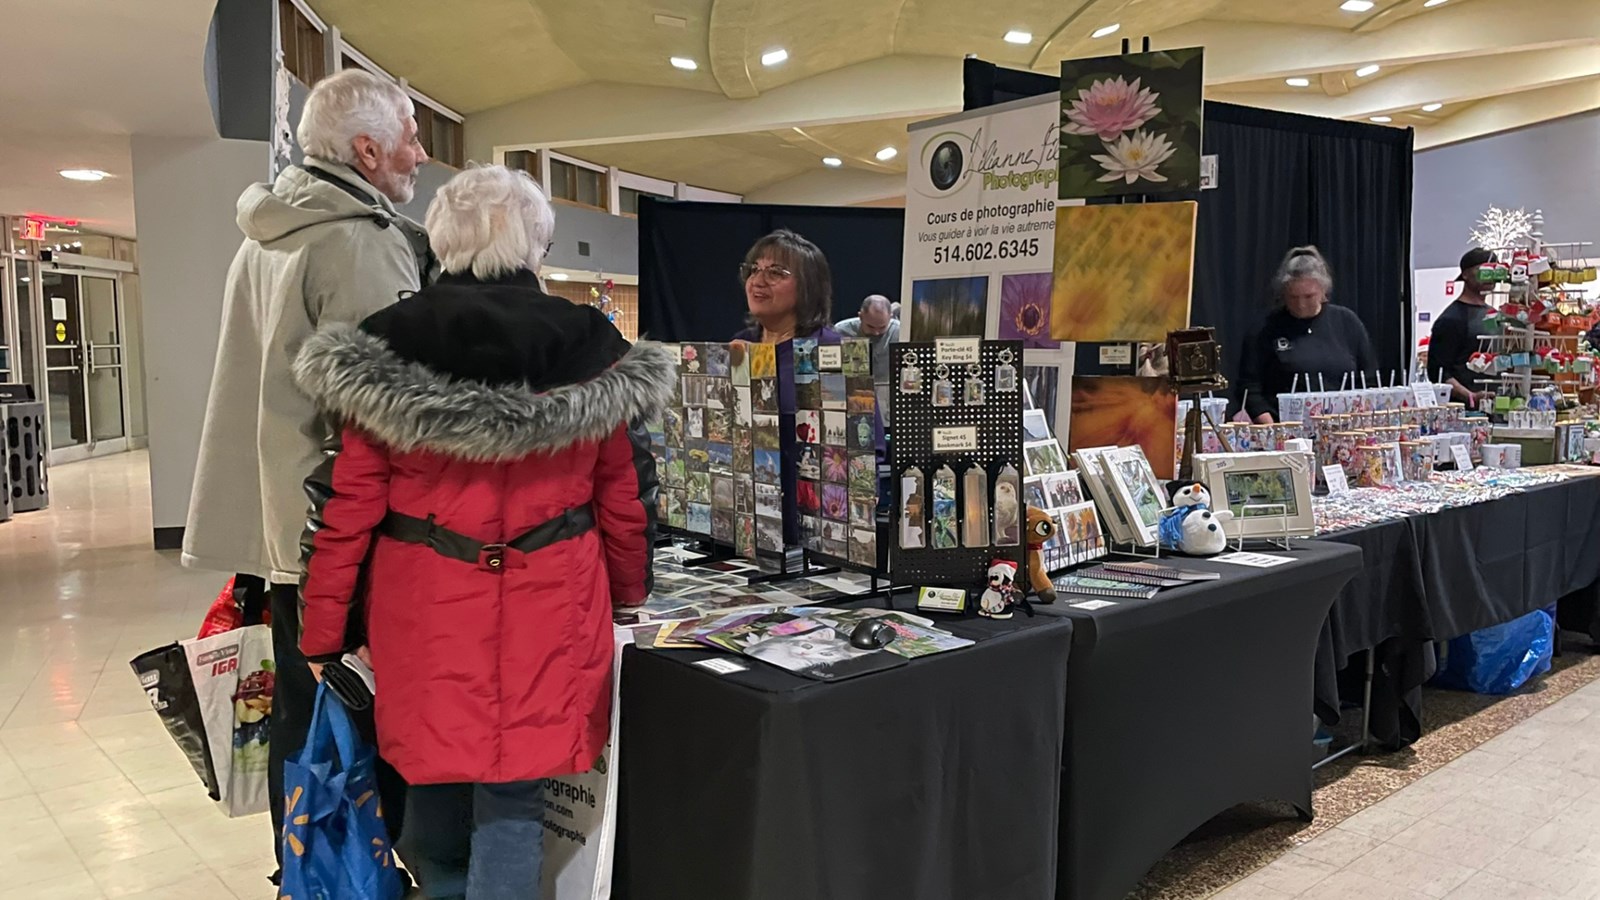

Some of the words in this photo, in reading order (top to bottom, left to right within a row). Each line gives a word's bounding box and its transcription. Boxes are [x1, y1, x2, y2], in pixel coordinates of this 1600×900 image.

[927, 212, 957, 225] Cours
[960, 208, 974, 221] de
[976, 198, 1055, 222] photographie
[918, 232, 937, 242] Vous
[938, 228, 965, 243] guider
[966, 226, 972, 238] à
[974, 225, 989, 237] voir
[991, 224, 999, 235] la
[1001, 222, 1015, 234] vie
[1016, 220, 1056, 233] autreme
[933, 238, 1039, 264] 514.602.6345
[211, 657, 238, 677] IGA
[543, 777, 596, 808] ographie
[544, 800, 574, 819] on.com
[543, 819, 587, 846] otographie
